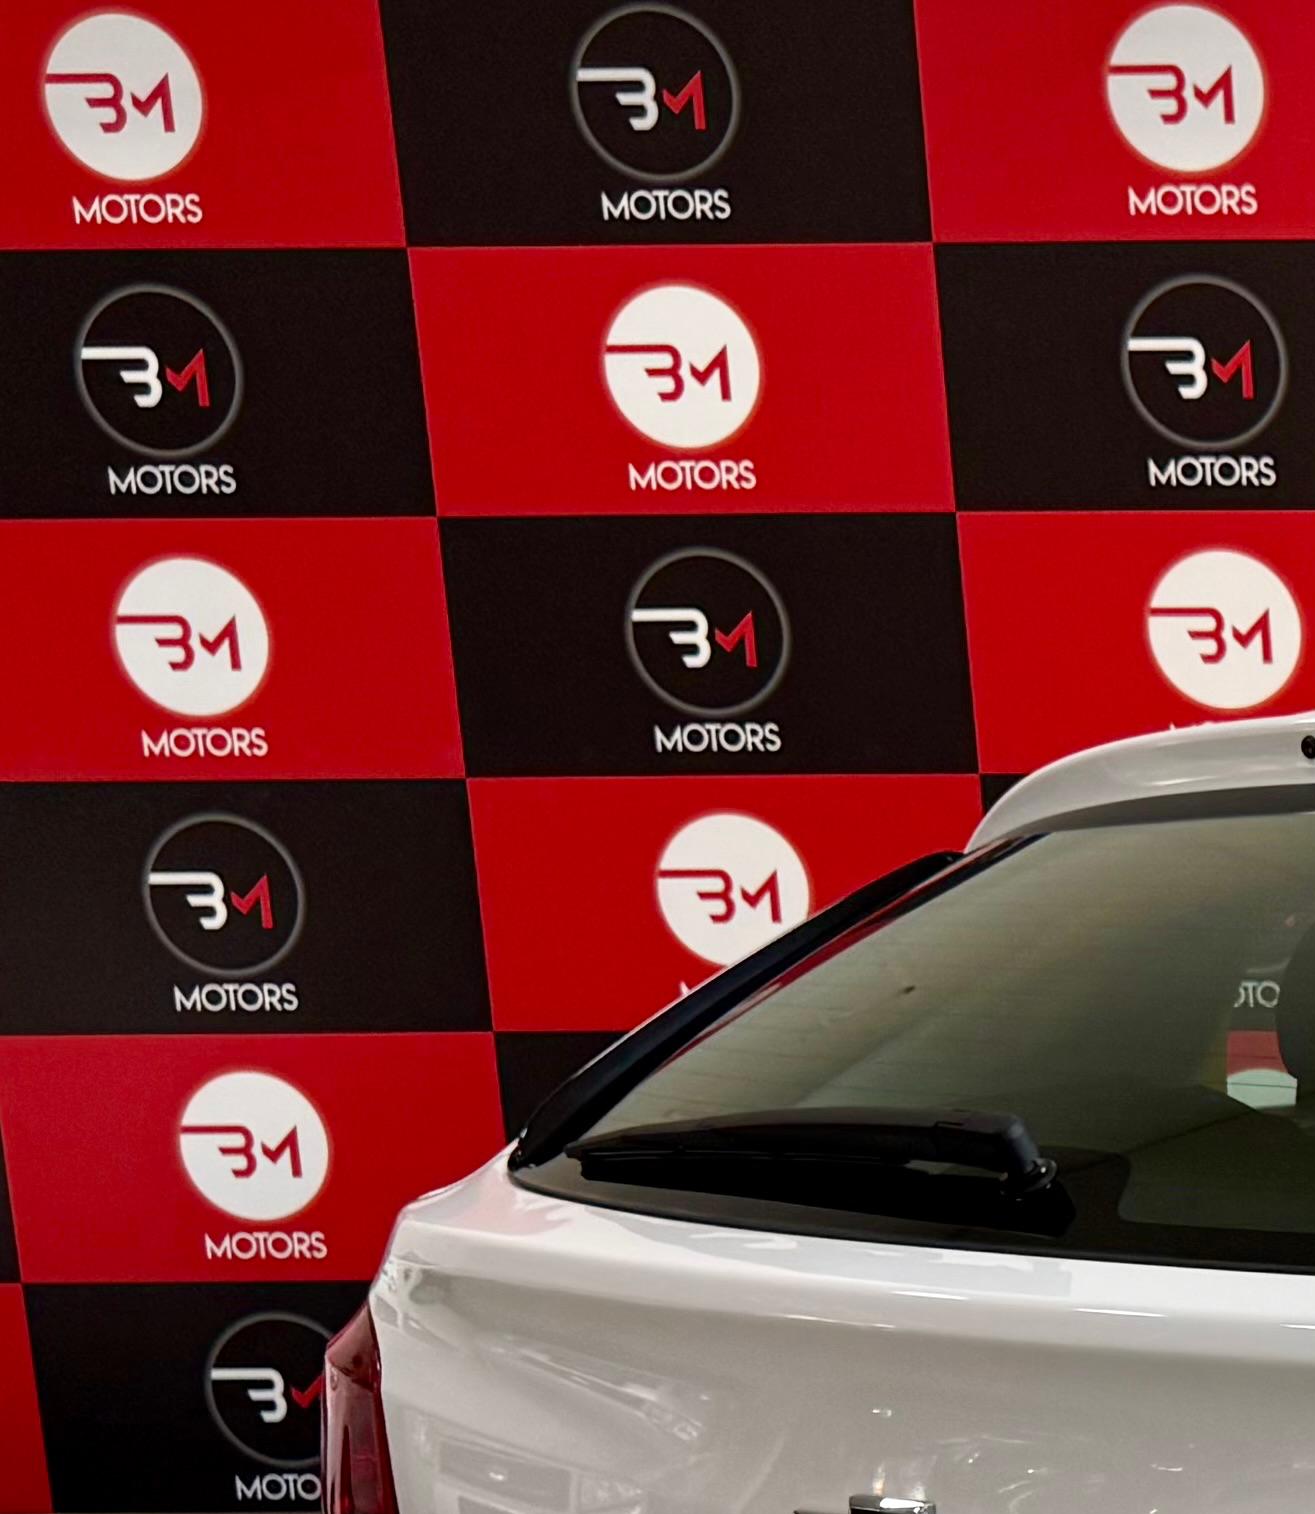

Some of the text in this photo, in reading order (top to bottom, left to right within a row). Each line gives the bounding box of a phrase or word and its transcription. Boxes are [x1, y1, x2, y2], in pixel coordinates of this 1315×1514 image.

[45, 72, 176, 133] BM
[577, 67, 706, 130] BM
[1109, 63, 1235, 125] BM
[73, 194, 202, 224] MOTORS
[601, 189, 730, 220] MOTORS
[1128, 184, 1257, 215] MOTORS
[81, 346, 209, 407] BM
[606, 344, 732, 402] BM
[1129, 337, 1254, 399] BM
[108, 465, 236, 494] MOTORS
[629, 460, 756, 490] MOTORS
[1149, 456, 1276, 486] MOTORS
[116, 614, 242, 672] BM
[631, 609, 757, 668] BM
[1150, 605, 1273, 664] BM
[142, 728, 268, 756] MOTORS
[655, 723, 781, 752] MOTORS
[148, 871, 273, 930] BM
[659, 869, 781, 925] BM
[174, 983, 298, 1011] MOTORS
[180, 1123, 302, 1180] BM
[205, 1232, 327, 1259] MOTORS
[235, 1473, 321, 1501] MOTO
